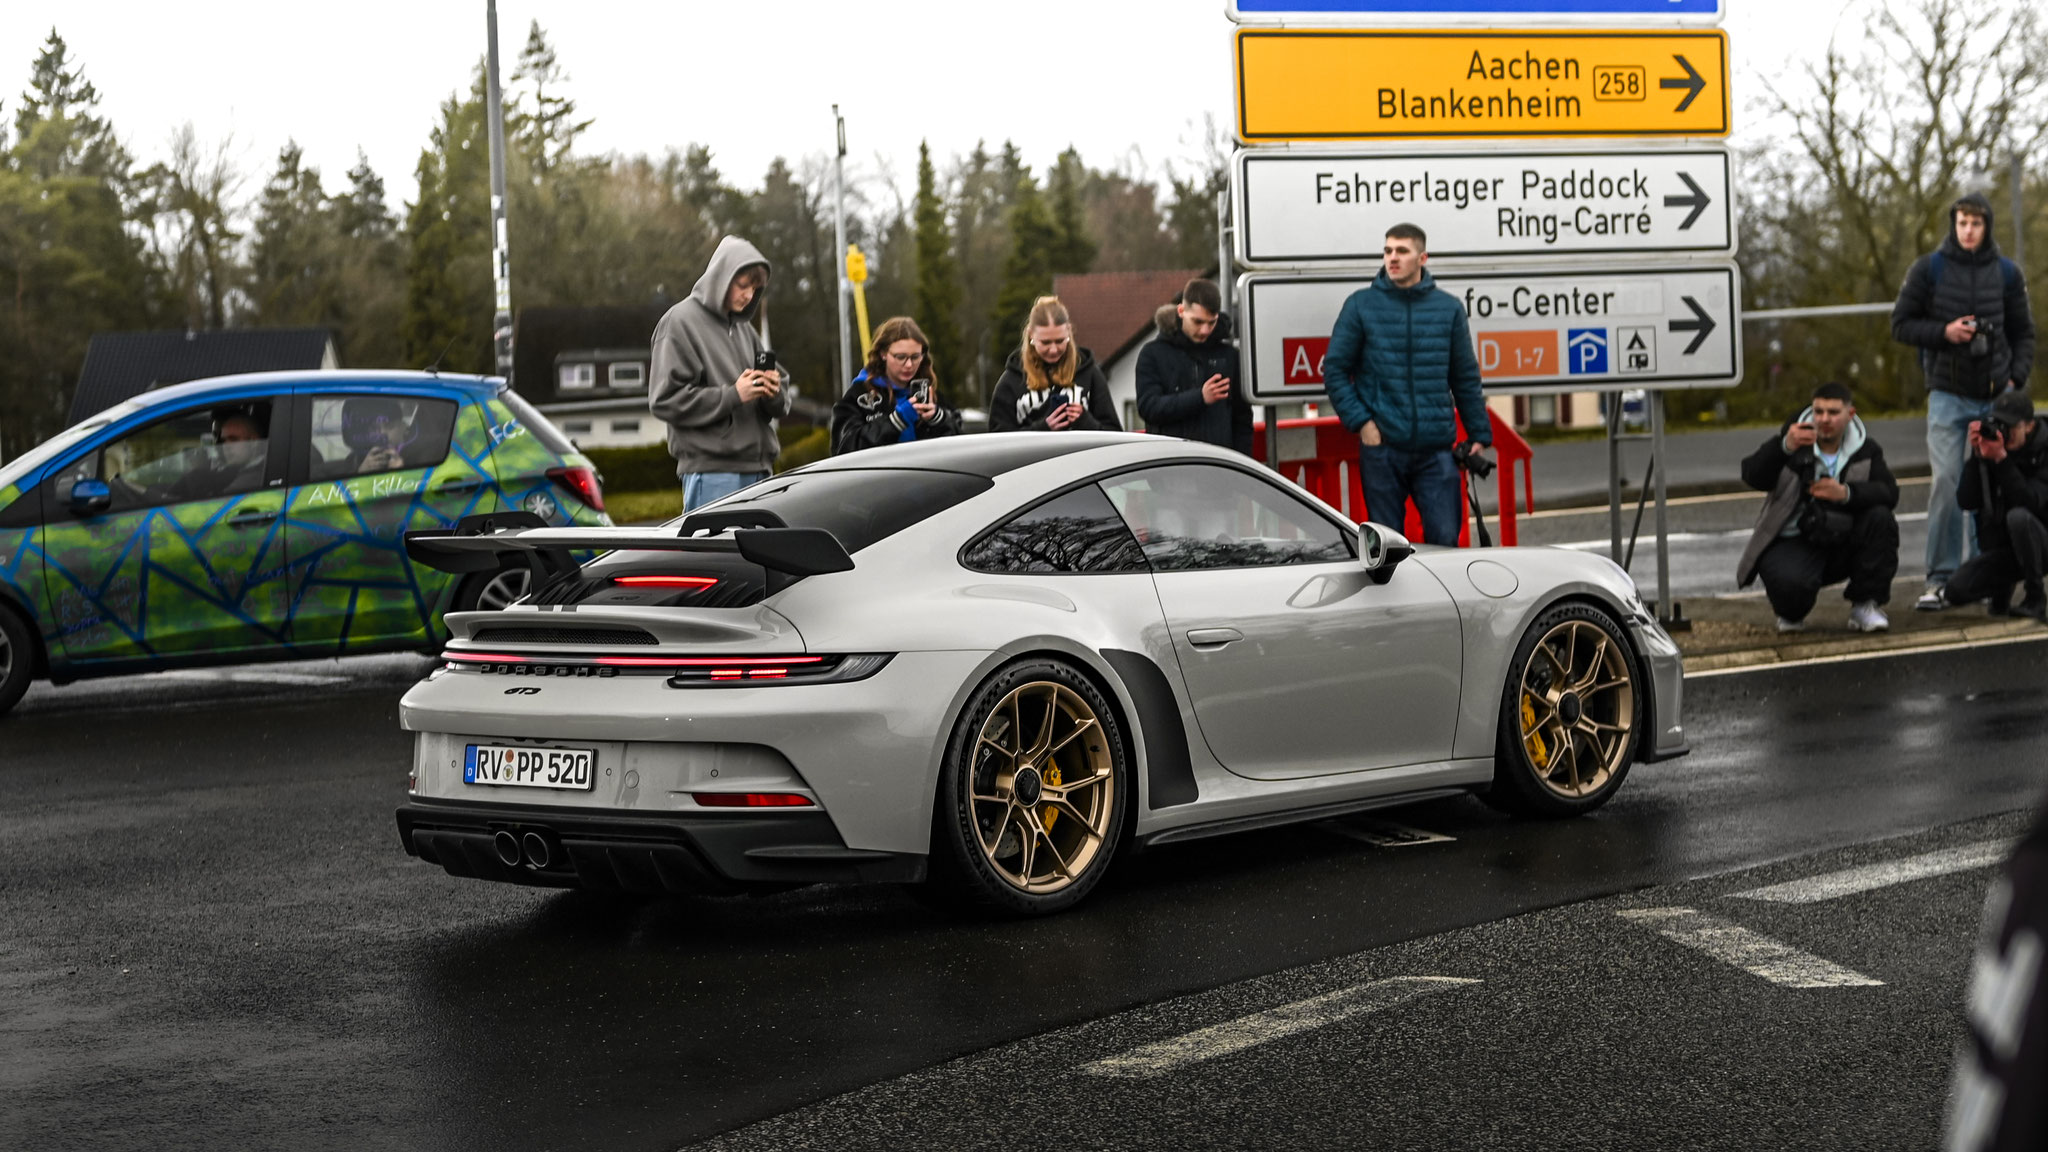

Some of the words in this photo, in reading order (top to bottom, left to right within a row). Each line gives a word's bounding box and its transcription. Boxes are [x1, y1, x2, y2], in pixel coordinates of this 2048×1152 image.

[1466, 50, 1580, 80] Aachen
[1600, 72, 1640, 95] 258
[1377, 87, 1581, 119] Blankenheim
[1316, 171, 1505, 210] Fahrerlager
[1522, 168, 1649, 200] Paddock
[1497, 204, 1652, 244] Ring-Carré
[1465, 285, 1615, 317] fo-Center
[1481, 339, 1500, 371] D
[1515, 346, 1545, 370] 1-7
[1580, 342, 1599, 373] P
[307, 481, 360, 505] AMG
[372, 475, 427, 498] Killer
[480, 664, 614, 677] PORSCHE
[476, 750, 504, 780] RV
[516, 751, 544, 783] PP
[547, 752, 589, 785] 520
